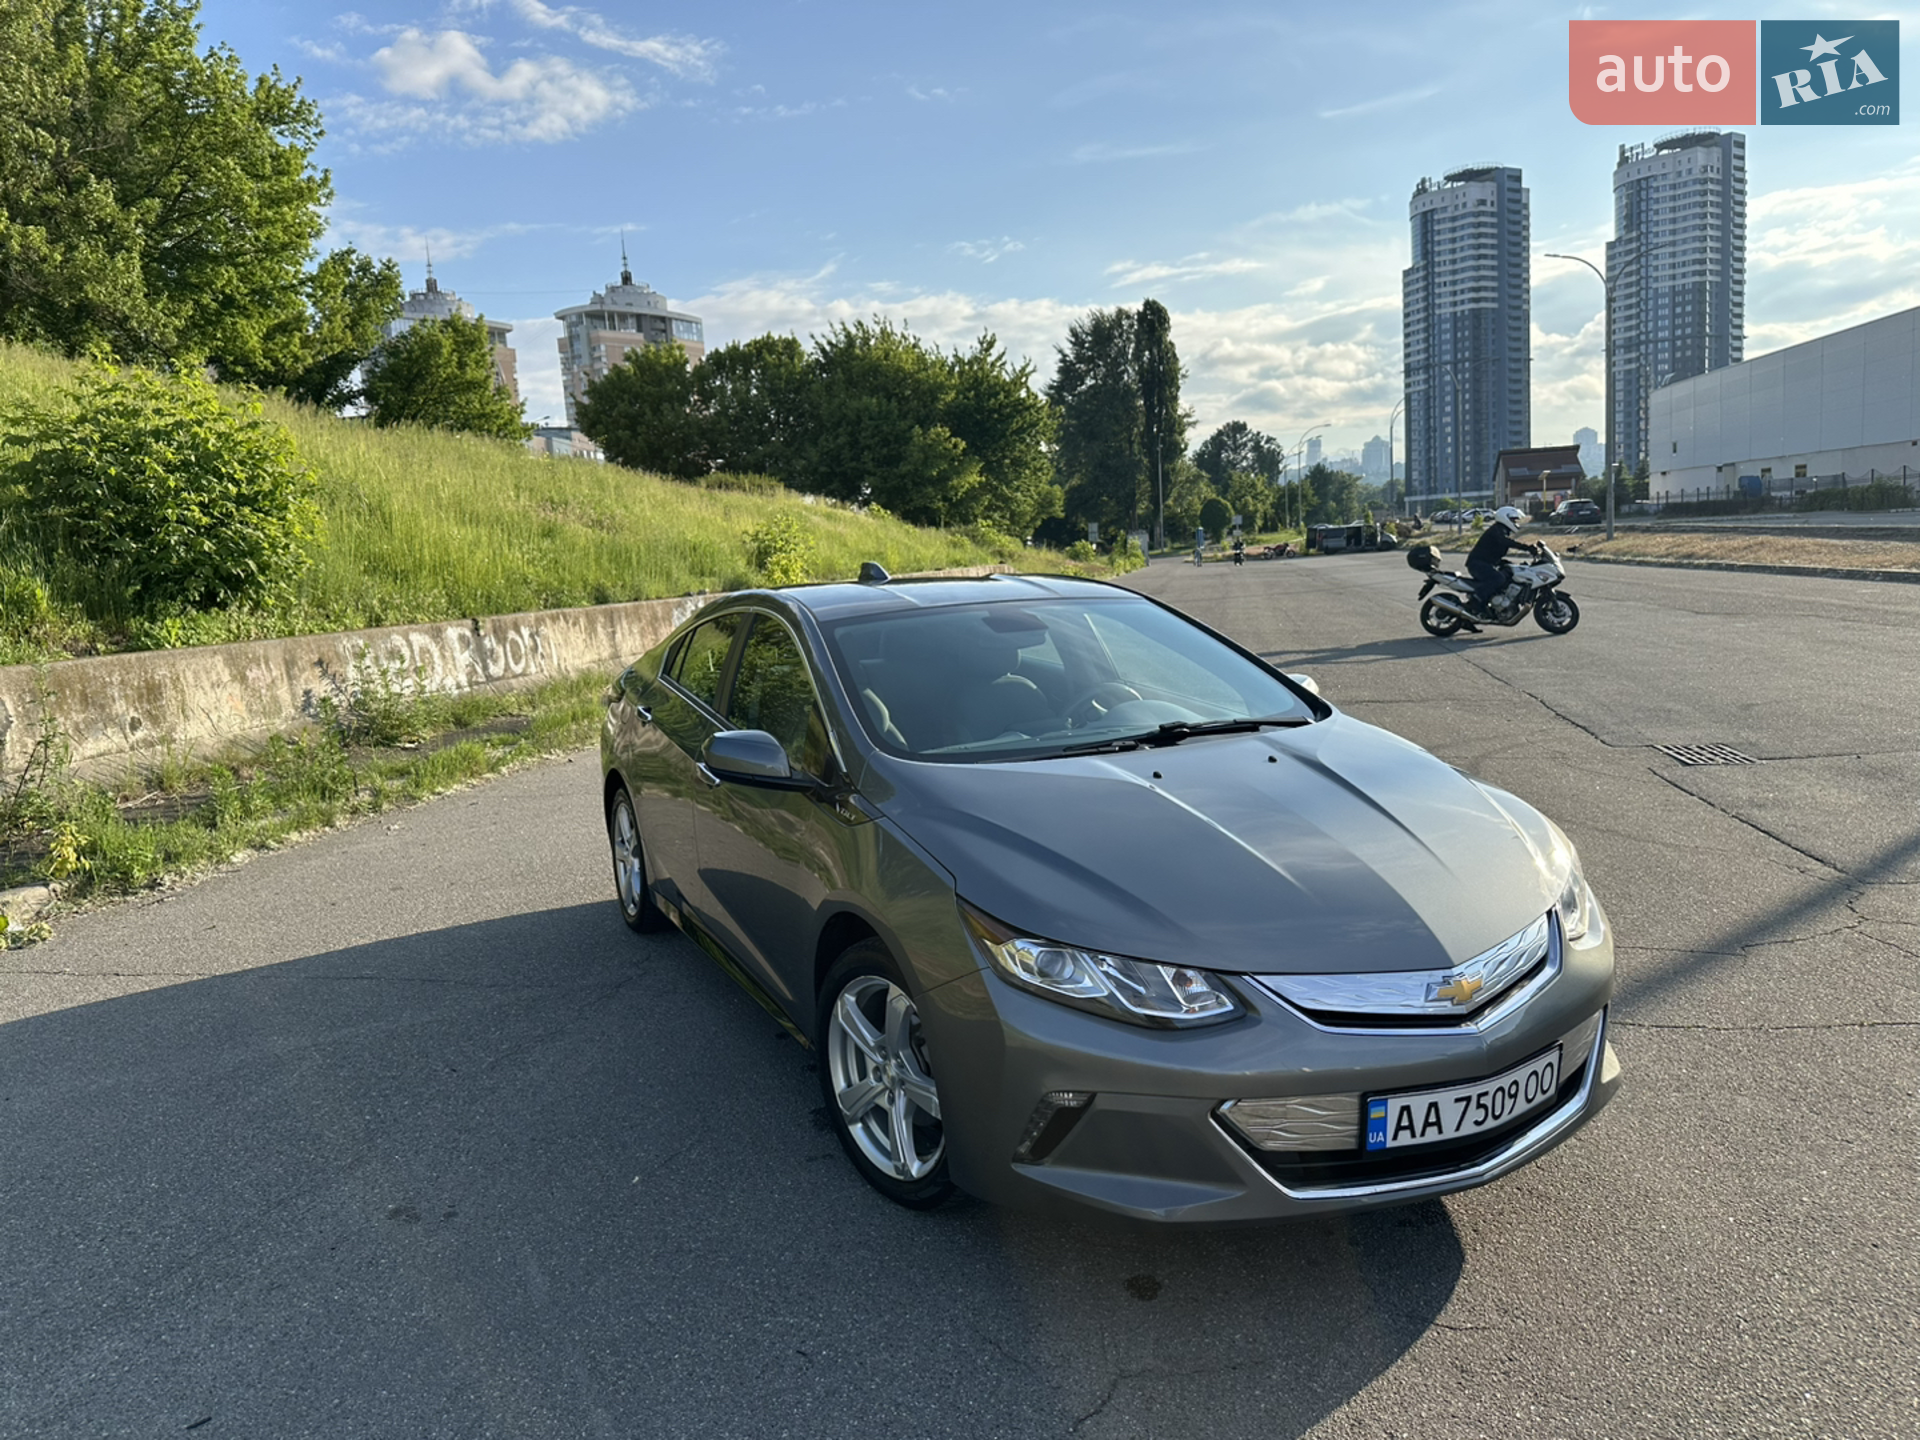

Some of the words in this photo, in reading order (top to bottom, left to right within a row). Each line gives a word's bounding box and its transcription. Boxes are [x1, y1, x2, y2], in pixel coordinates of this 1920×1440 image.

[1391, 1101, 1443, 1142] AA
[1453, 1079, 1520, 1133] 7509
[1368, 1131, 1385, 1144] UA
